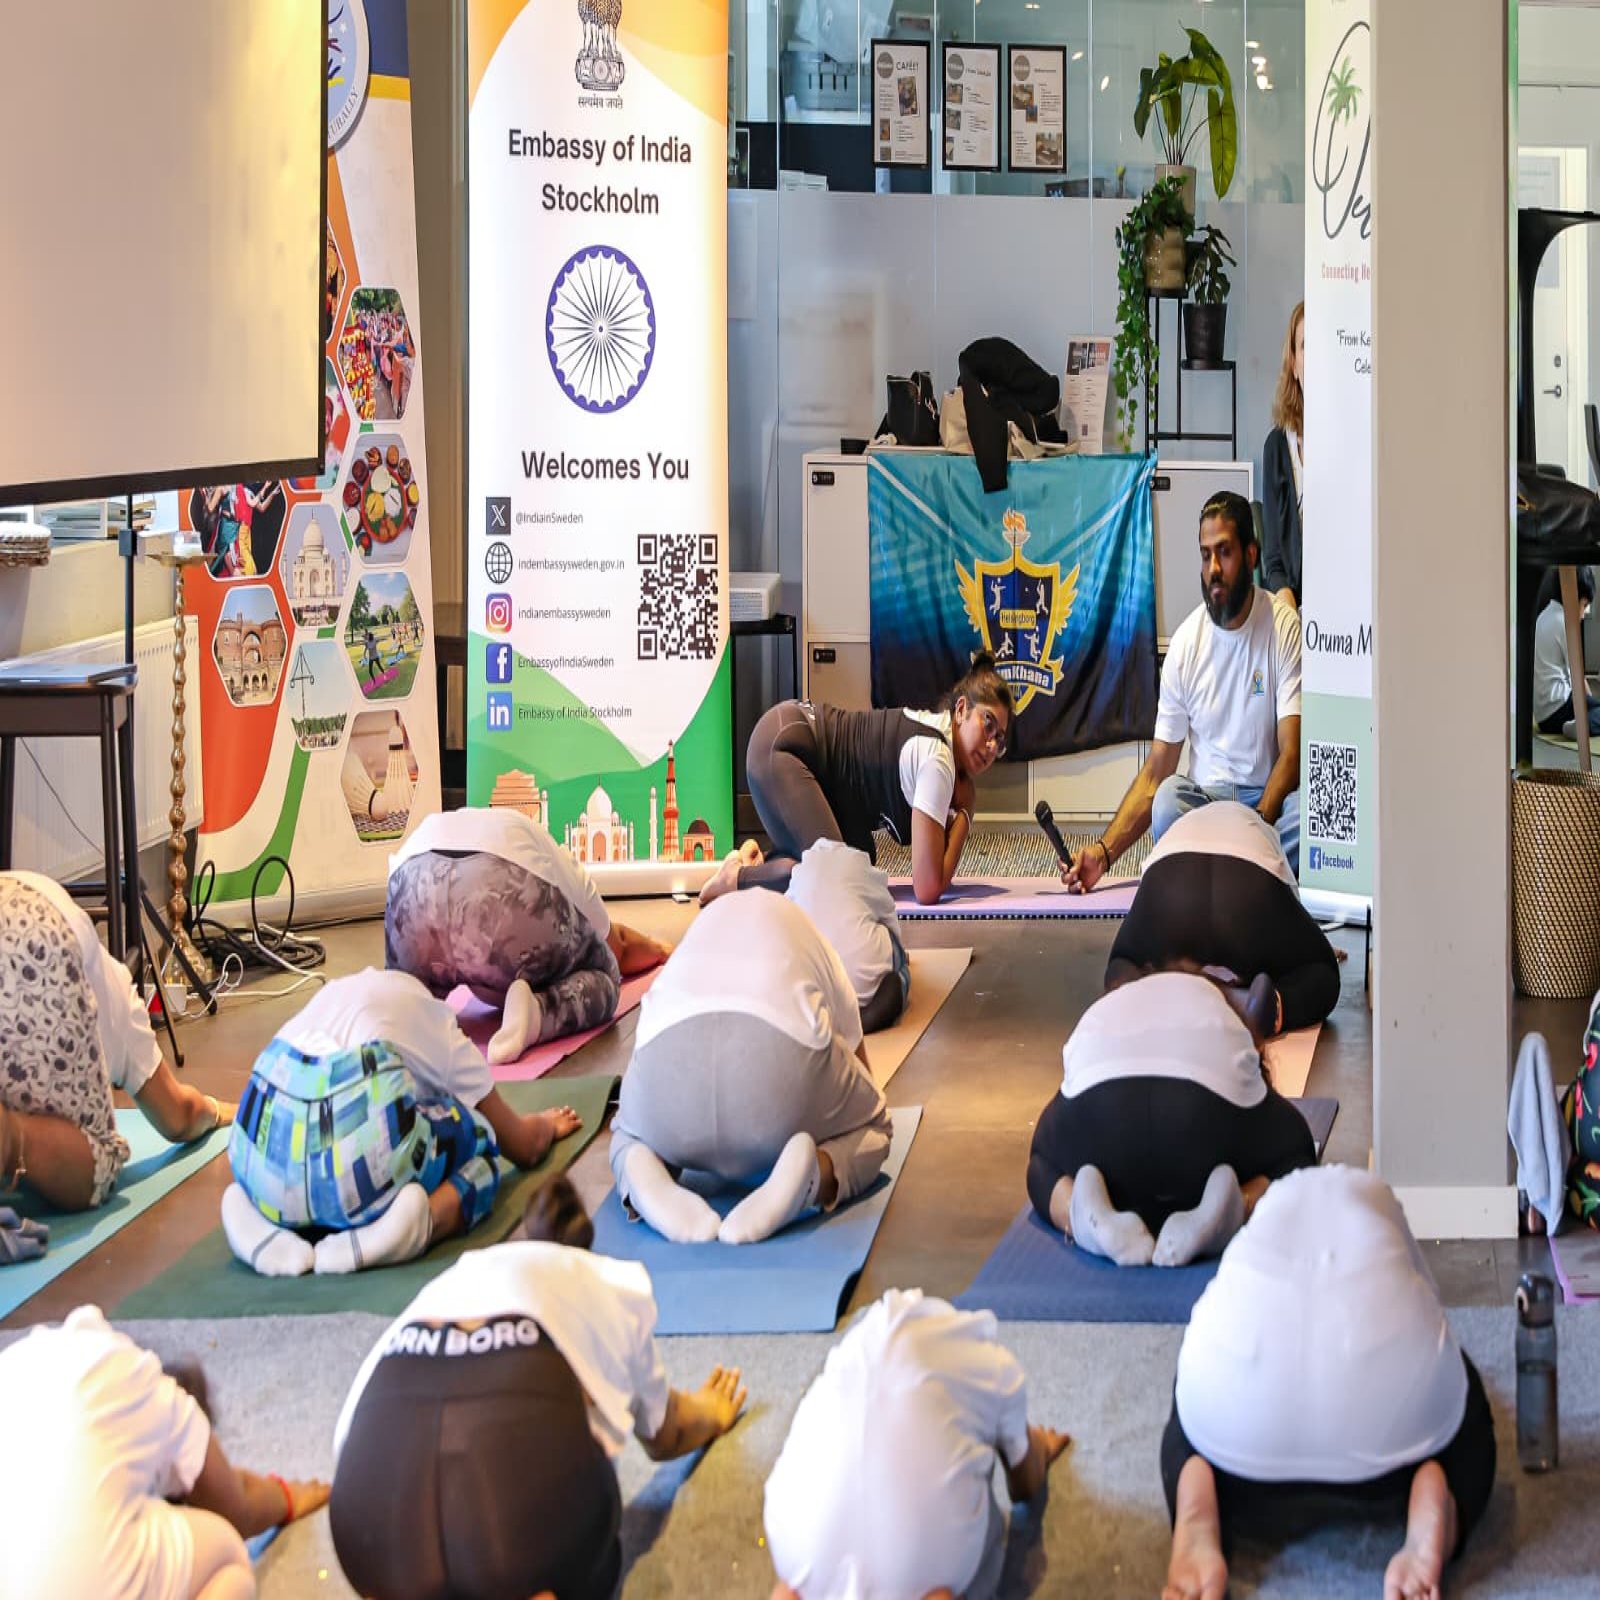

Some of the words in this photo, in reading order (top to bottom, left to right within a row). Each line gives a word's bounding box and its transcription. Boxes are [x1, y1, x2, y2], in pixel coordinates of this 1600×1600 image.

[508, 129, 606, 166] Embassy
[612, 136, 634, 161] of
[641, 136, 691, 163] India
[542, 184, 659, 214] Stockholm
[1321, 262, 1359, 283] Connecting
[521, 451, 641, 480] Welcomes
[648, 453, 689, 480] You
[516, 512, 583, 525] @IndiainSweden
[518, 558, 625, 573] indembassysweden.gov.in
[518, 607, 611, 622] indianembassysweden
[1306, 620, 1352, 655] Oruma
[1357, 623, 1372, 656] M
[518, 656, 614, 671] EmbassyofIndiaSweden
[518, 708, 555, 721] Embassy
[558, 707, 565, 718] of
[568, 707, 588, 718] India
[590, 707, 632, 719] Stockholm
[1322, 852, 1354, 870] facebook
[444, 1320, 540, 1356] BORG
